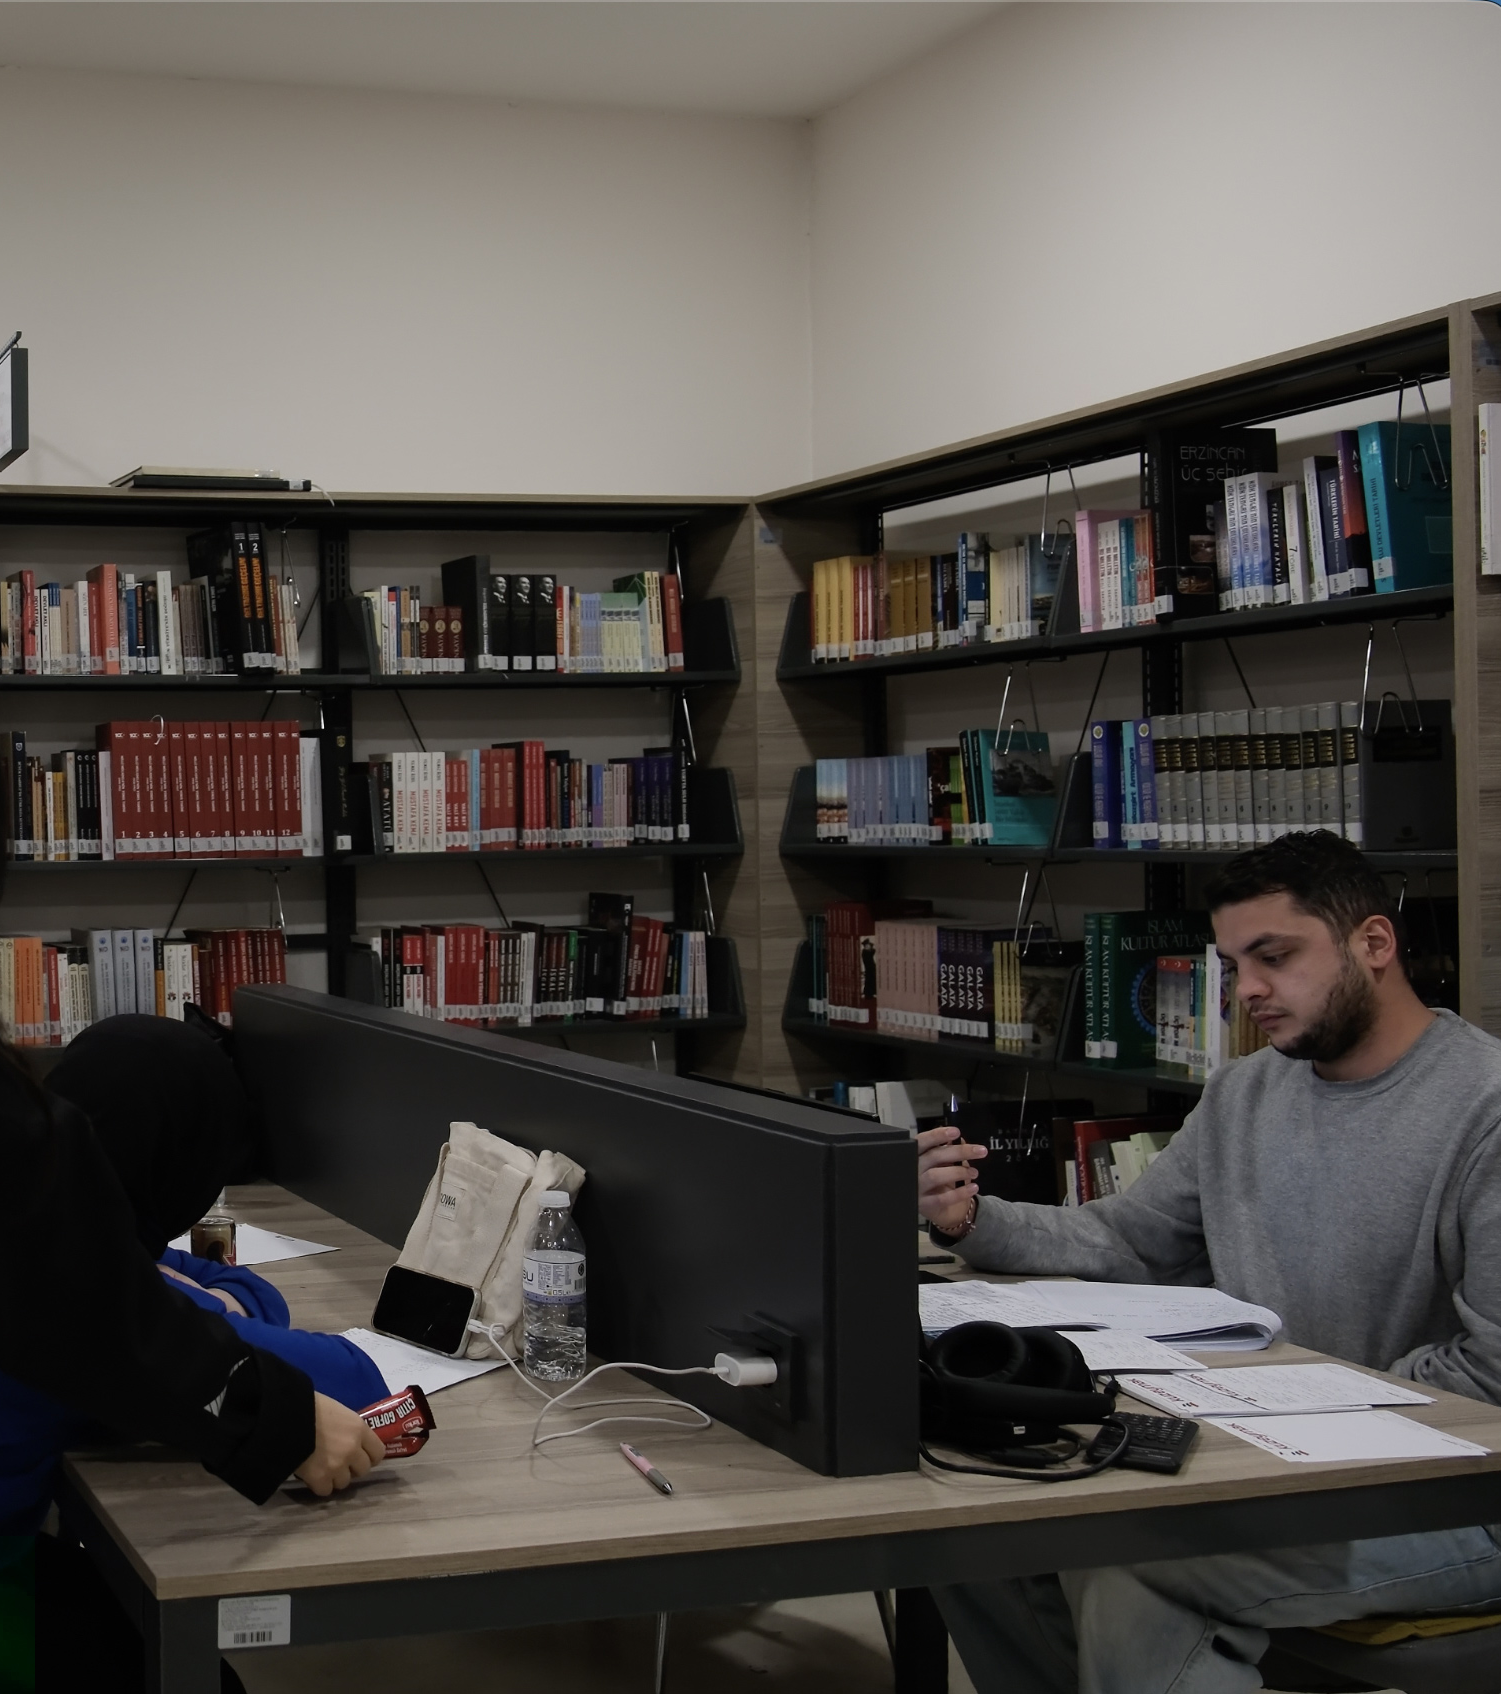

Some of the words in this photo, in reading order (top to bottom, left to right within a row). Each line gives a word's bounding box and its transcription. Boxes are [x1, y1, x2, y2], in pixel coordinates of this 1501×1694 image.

[1180, 443, 1246, 461] ERZİNCAN
[1329, 480, 1338, 516] TÜRKLERİN
[1369, 477, 1379, 501] TARİHİ
[940, 963, 948, 1006] GALATA
[948, 964, 956, 1008] GALATA
[957, 965, 965, 1008] GALATA
[966, 966, 974, 1010] GALATA
[976, 966, 984, 1011] GALATA
[1085, 968, 1094, 1008] KÜLTÜR
[1102, 968, 1111, 1008] KÜLTÜR
